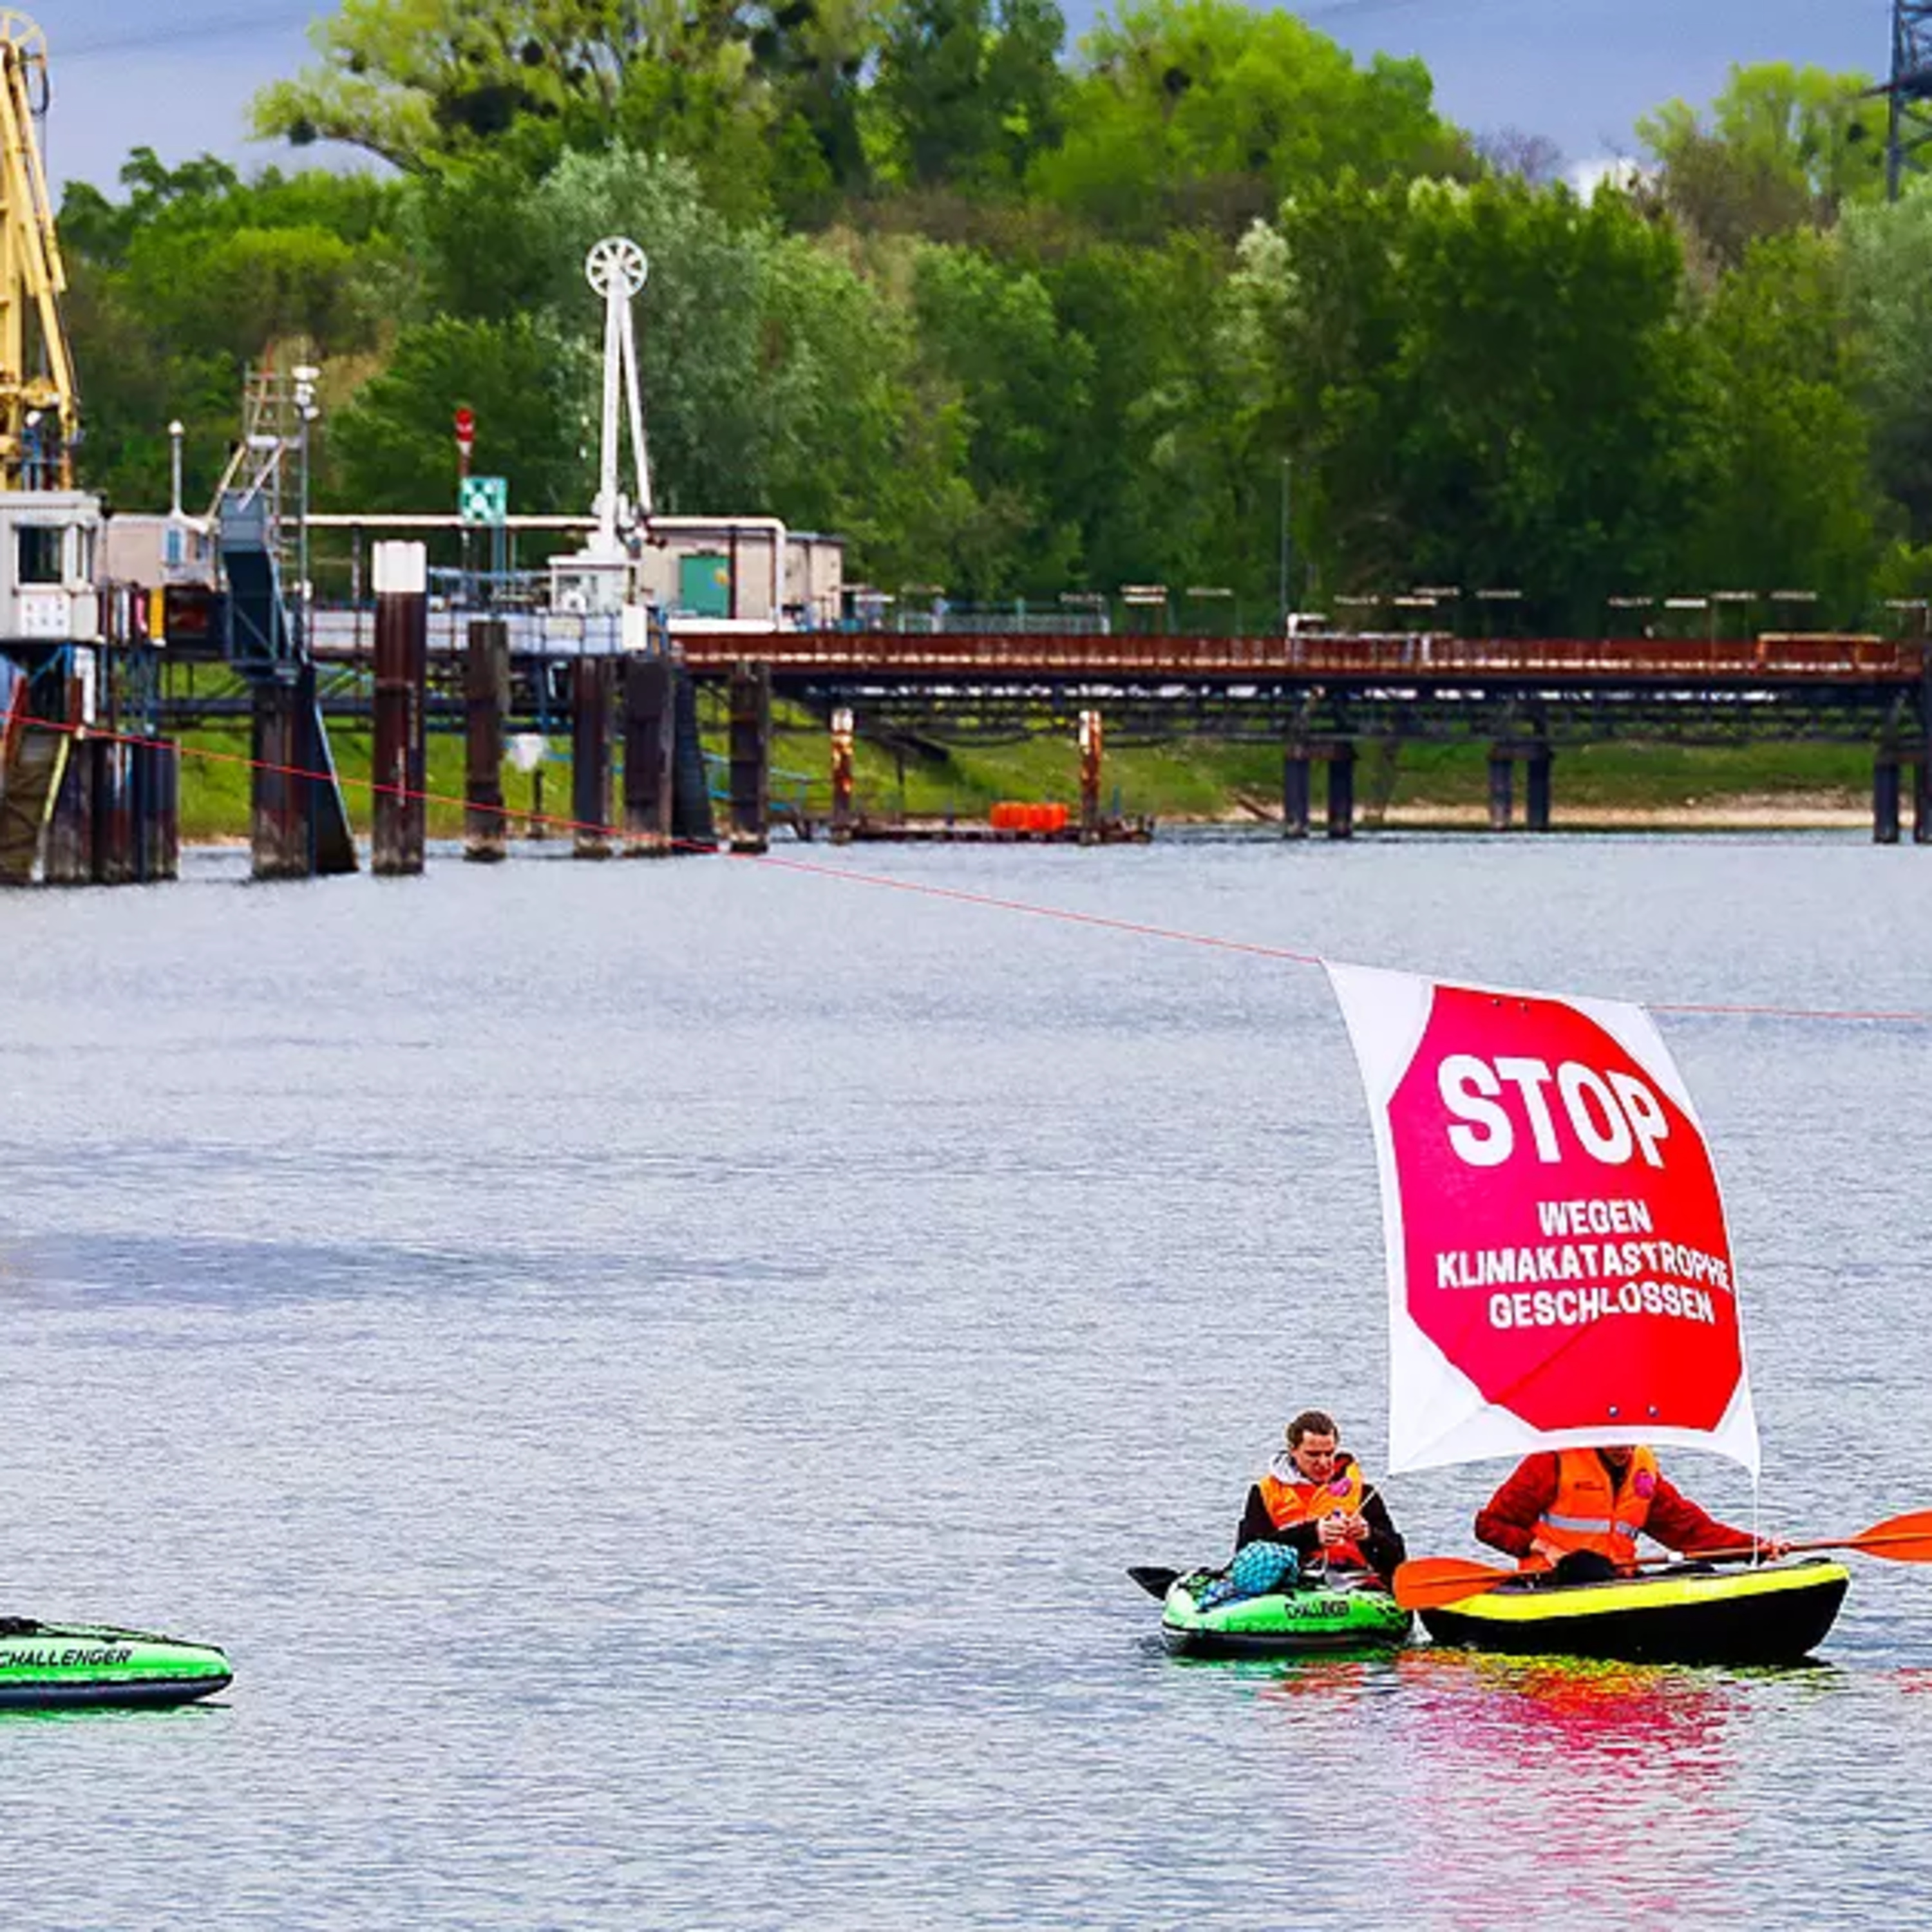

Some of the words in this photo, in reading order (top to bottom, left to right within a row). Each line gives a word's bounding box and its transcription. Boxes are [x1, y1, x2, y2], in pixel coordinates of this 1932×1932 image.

[1436, 1054, 1669, 1168] STOP
[1537, 1200, 1653, 1236] WEGEN
[1436, 1242, 1731, 1291] KLIMAKATASTROPHE
[1490, 1282, 1715, 1328] GESCHLOSSEN
